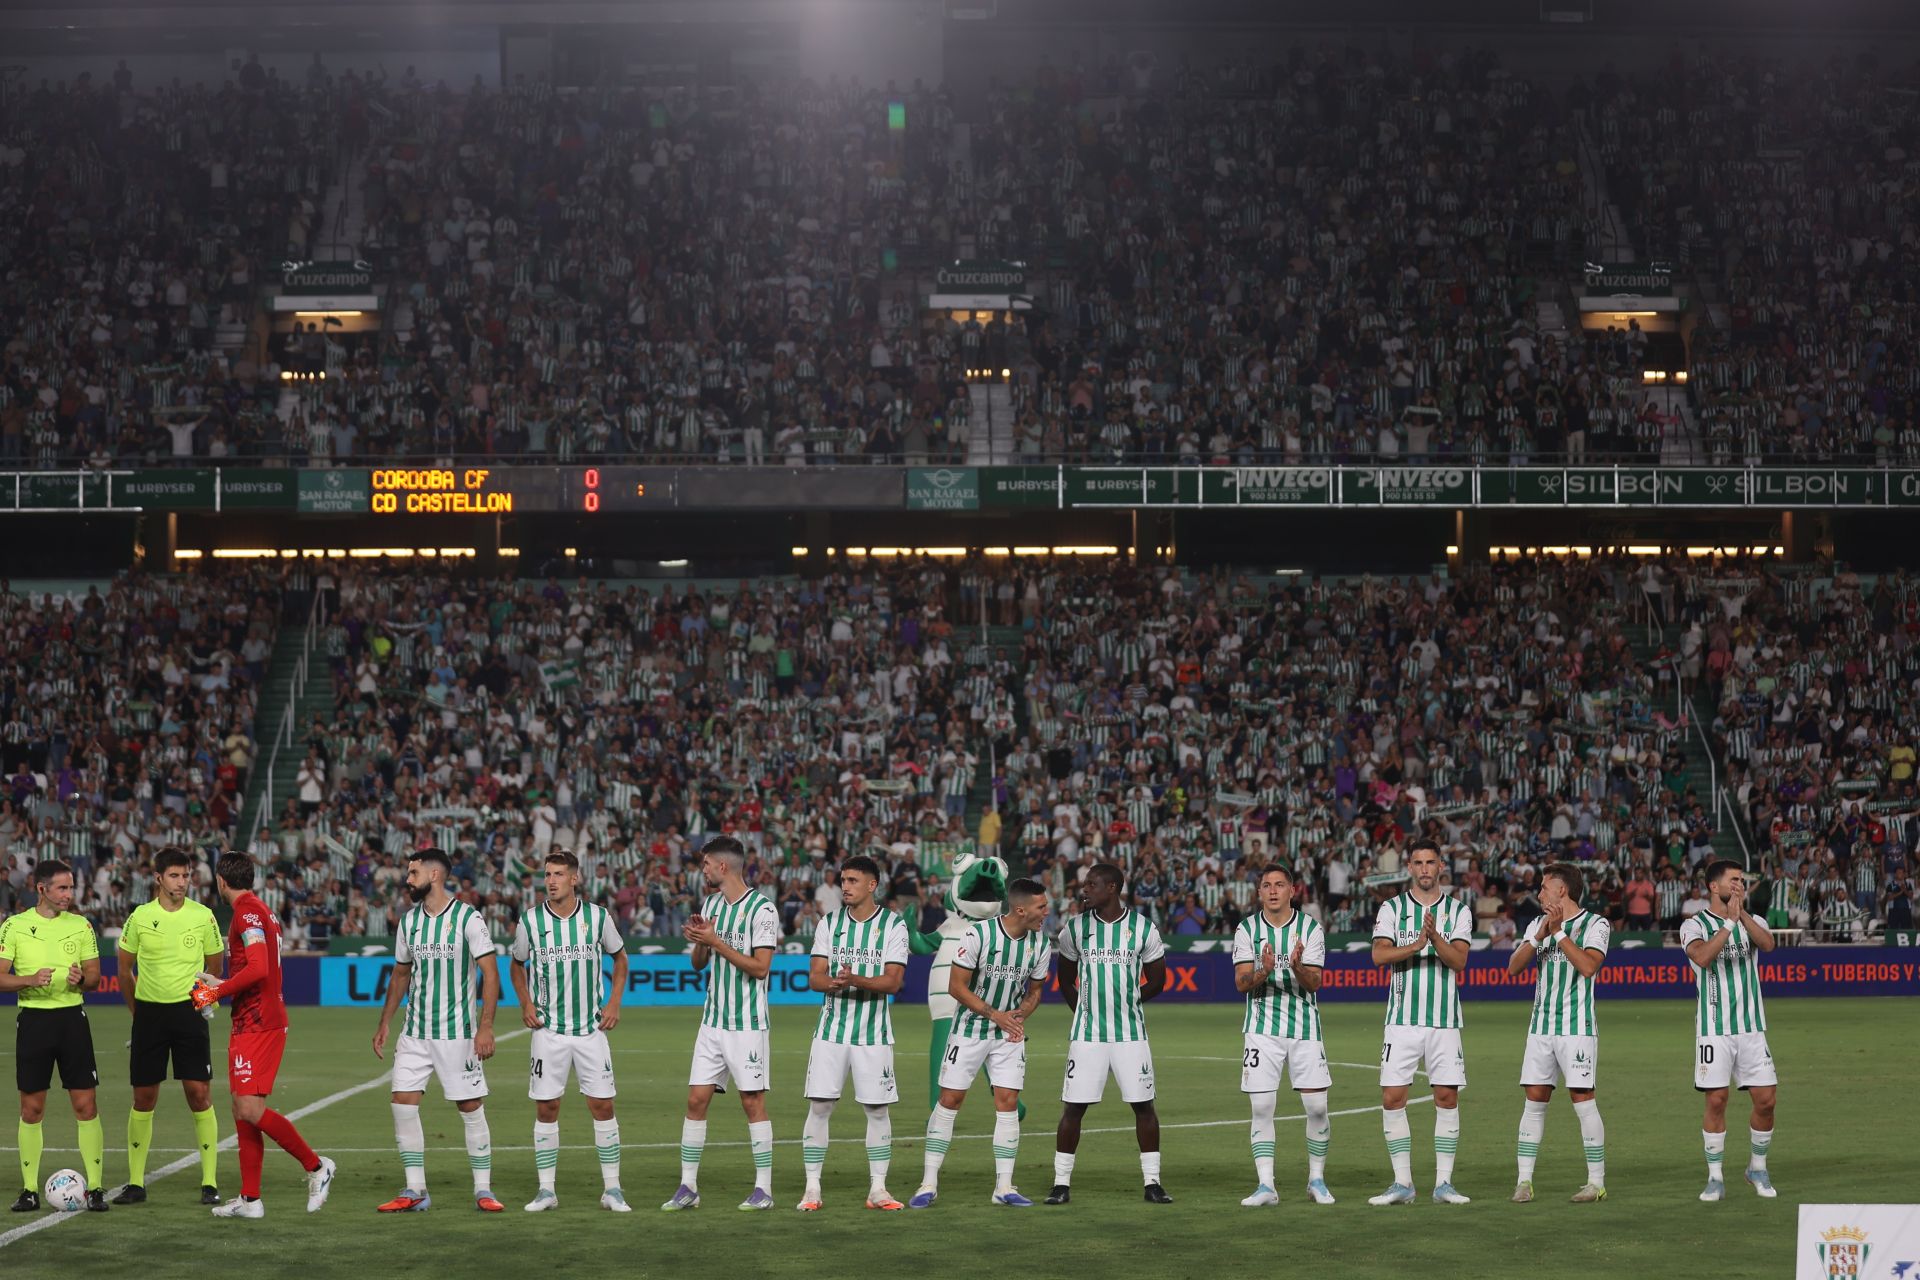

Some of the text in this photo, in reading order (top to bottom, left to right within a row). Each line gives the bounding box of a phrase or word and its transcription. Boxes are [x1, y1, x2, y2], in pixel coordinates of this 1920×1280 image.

[285, 270, 369, 287] Cruzcampo
[938, 268, 1023, 286] Cruzcampo
[1586, 273, 1669, 289] Cruzcampo
[464, 470, 489, 489] CF
[584, 469, 598, 488] 0
[1222, 469, 1329, 487] PINVECO
[1358, 469, 1464, 487] PINVECO
[1568, 475, 1683, 494] SILBON
[1734, 475, 1848, 494] SILBON
[136, 483, 195, 493] URBYSER
[225, 483, 283, 493] URBYSER
[1009, 481, 1067, 490] URBYSER
[1097, 480, 1156, 490] URBYSER
[299, 490, 366, 500] SAN RAFAEL
[909, 489, 978, 499] SAN RAFAEL
[313, 501, 353, 511] MOTOR
[372, 493, 512, 512] CD CASTELLON
[584, 493, 598, 511] 0
[923, 499, 964, 509] MOTOR
[409, 944, 454, 952] BAHRAIN
[540, 945, 593, 955] BAHRAIN
[832, 947, 881, 958] BAHRAIN
[1084, 949, 1134, 957] BAHRAIN
[986, 965, 1032, 976] BAHRAIN
[987, 972, 1020, 981] VICTORIO
[1469, 967, 1537, 985] INOXIDA
[1822, 964, 1900, 982] TUBEROS
[1904, 964, 1913, 981] Y
[1243, 1048, 1260, 1068] 23
[1699, 1044, 1714, 1064] 10
